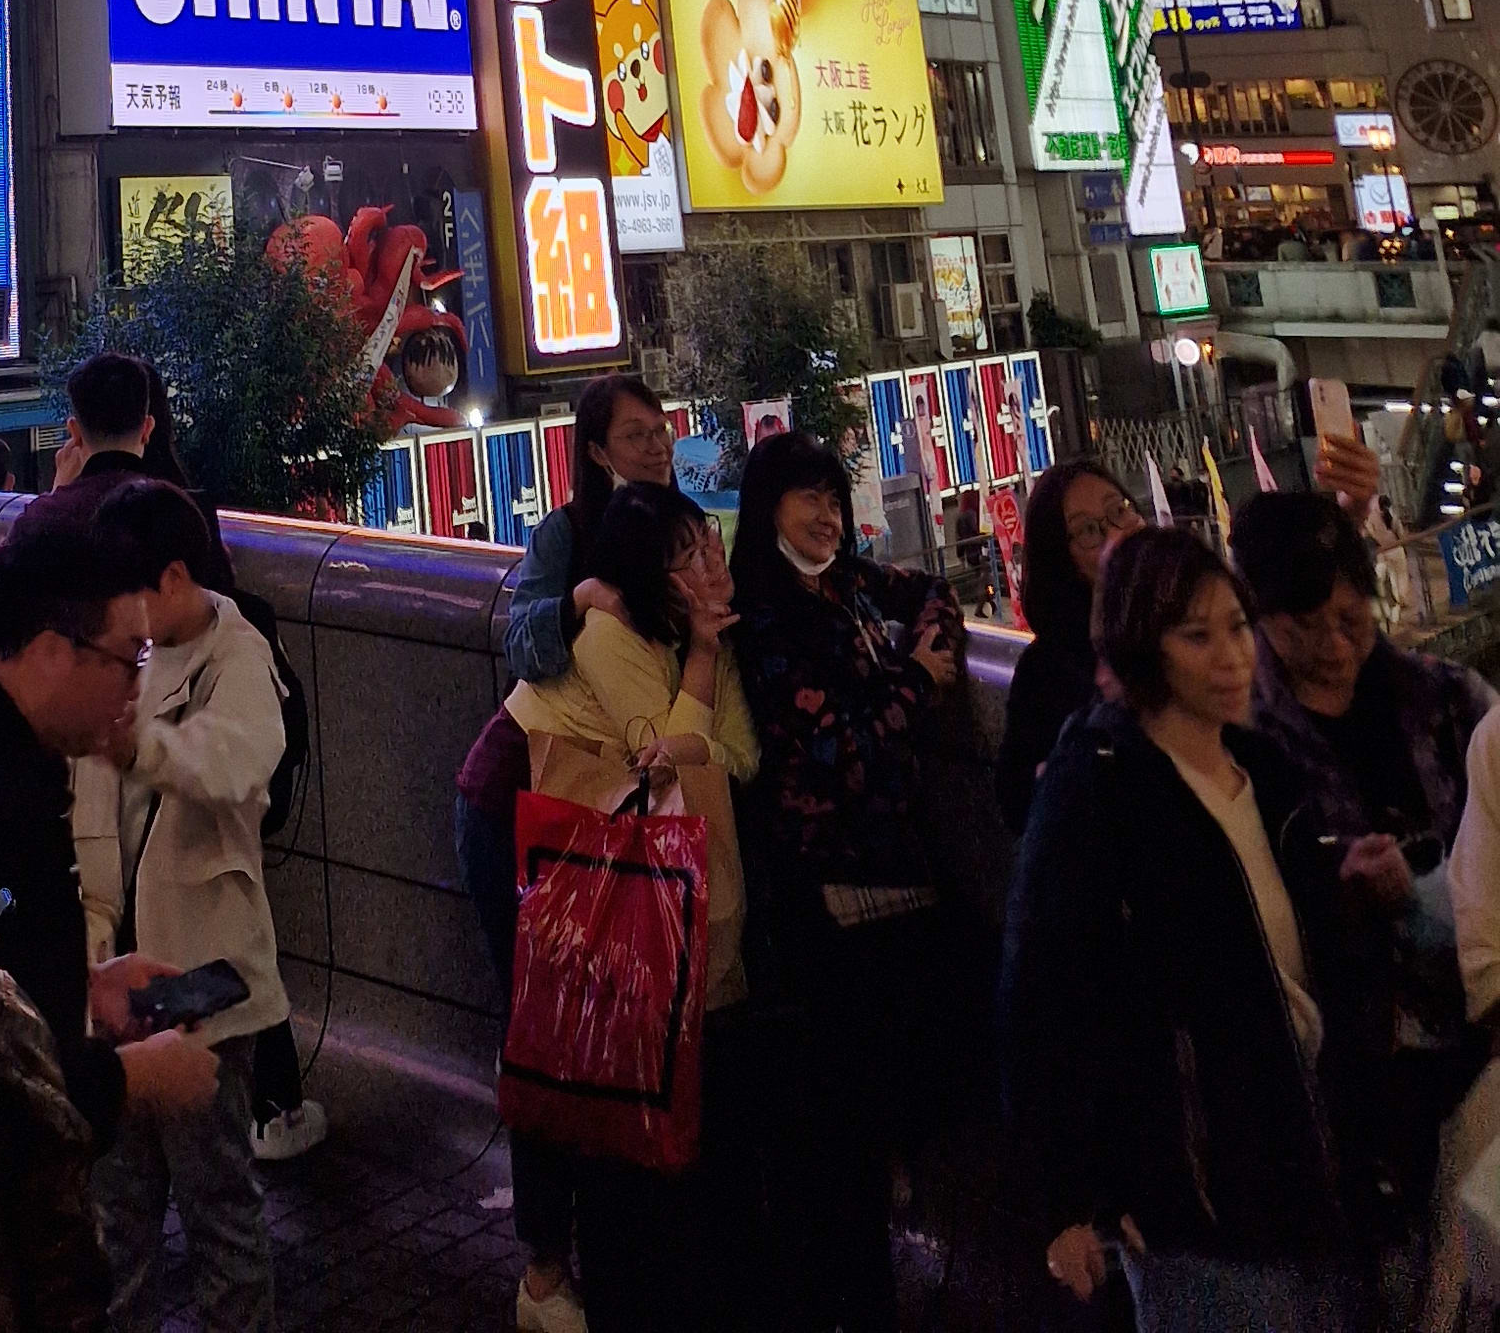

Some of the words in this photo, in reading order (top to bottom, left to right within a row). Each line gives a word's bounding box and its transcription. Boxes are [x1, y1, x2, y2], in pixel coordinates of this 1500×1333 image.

[815, 60, 872, 90] 大阪土産
[126, 84, 181, 110] 天気予報
